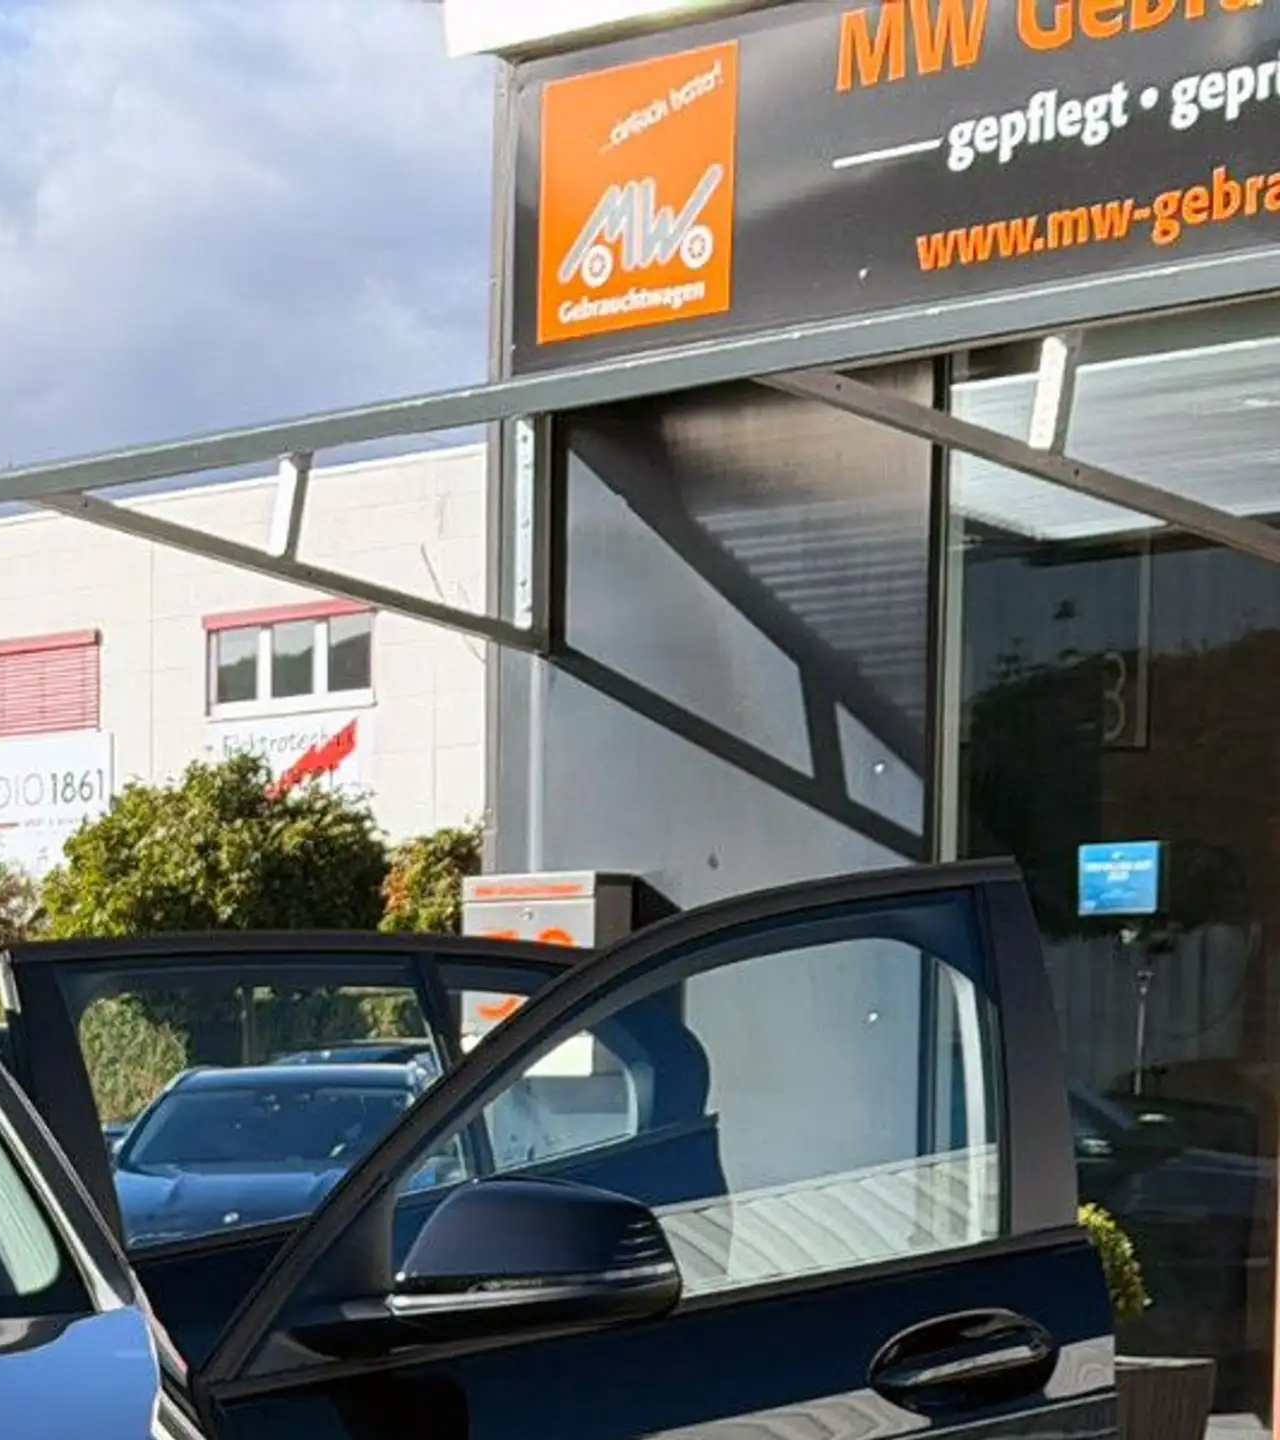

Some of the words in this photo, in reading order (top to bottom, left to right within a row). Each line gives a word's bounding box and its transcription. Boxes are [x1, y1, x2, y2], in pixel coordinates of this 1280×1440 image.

[836, 0, 989, 92] MW
[948, 81, 1130, 171] gepflegt
[1170, 48, 1280, 130] gepr
[558, 281, 705, 324] Gebrauchtwagen
[50, 768, 104, 806] 1861
